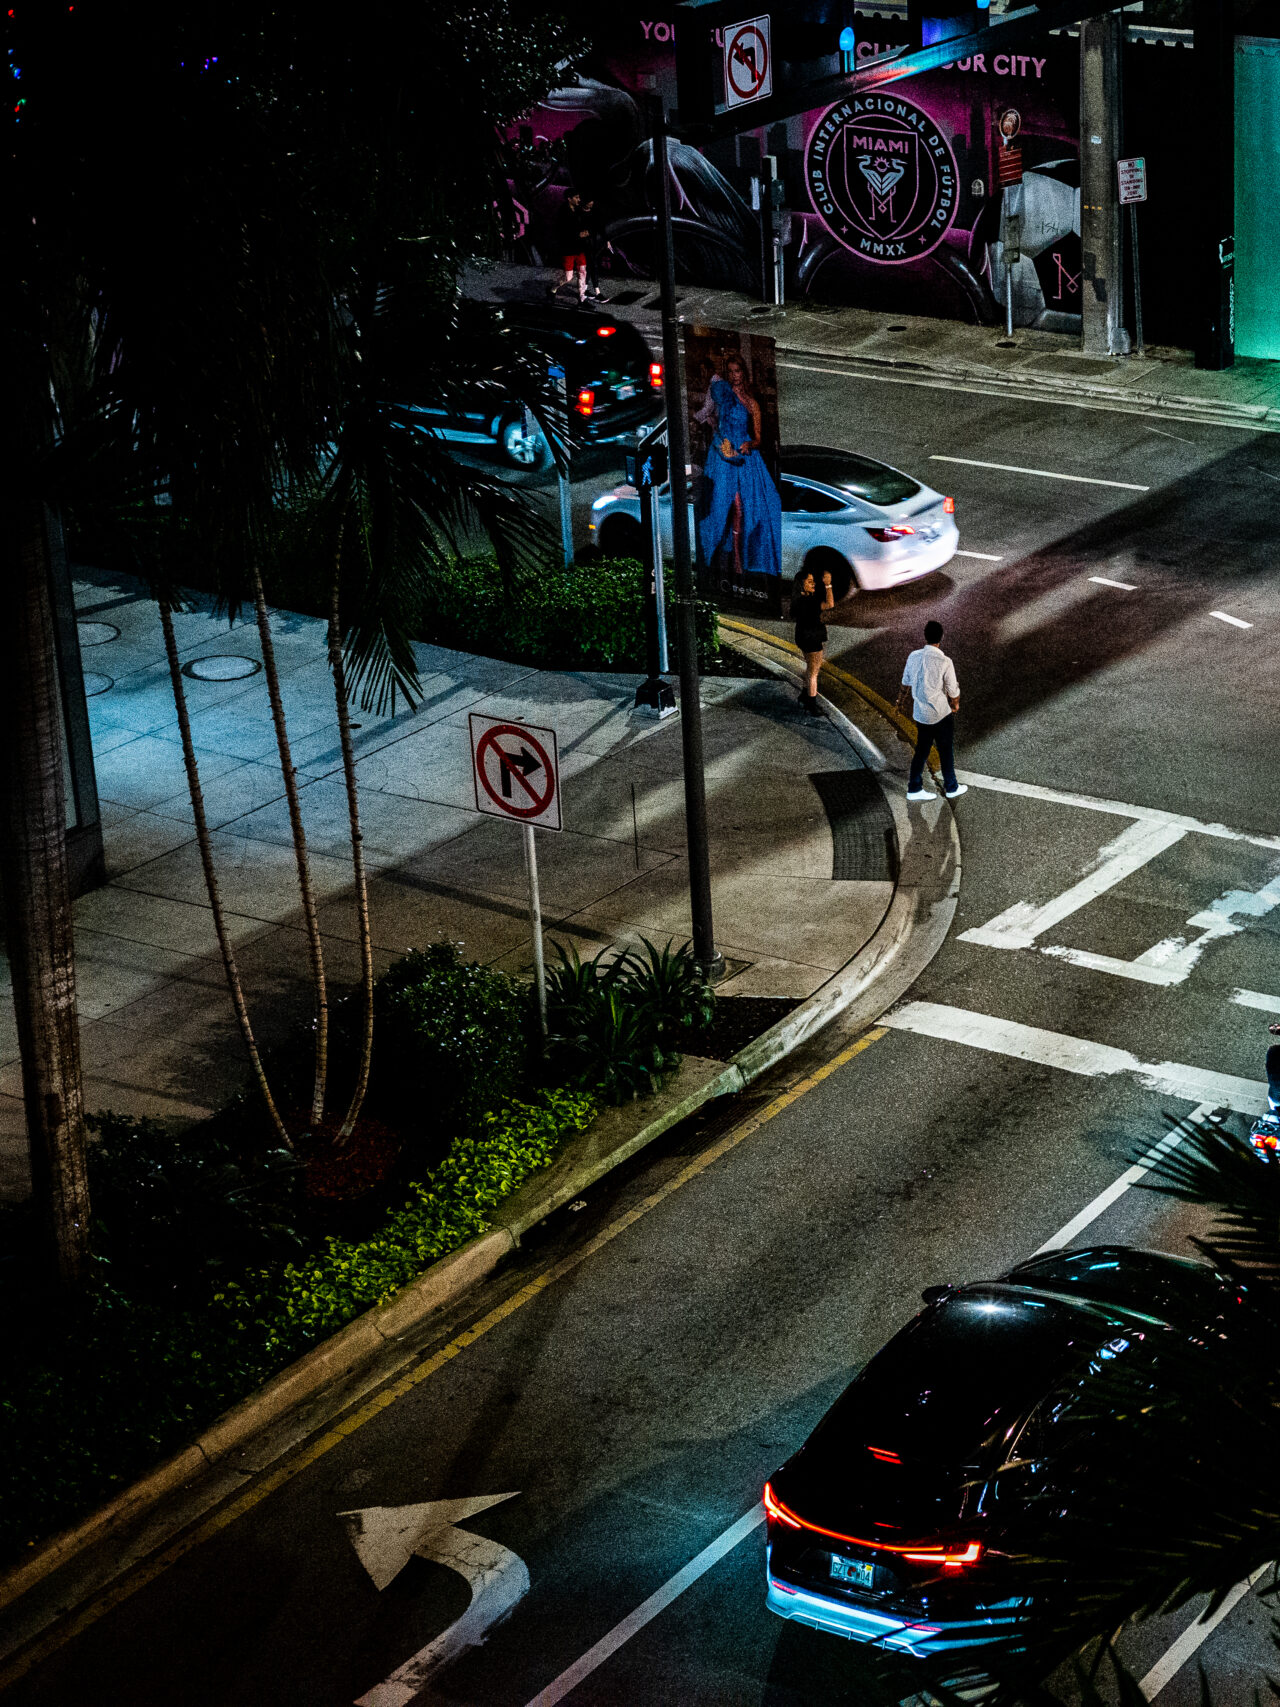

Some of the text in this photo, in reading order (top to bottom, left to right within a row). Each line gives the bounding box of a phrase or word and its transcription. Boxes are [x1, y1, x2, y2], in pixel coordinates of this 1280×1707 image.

[993, 54, 1047, 79] CITY
[852, 135, 909, 154] MIAMI
[812, 98, 955, 229] CLUB INTERNACIONAL DE FÚTBOL
[860, 237, 906, 256] MMXX
